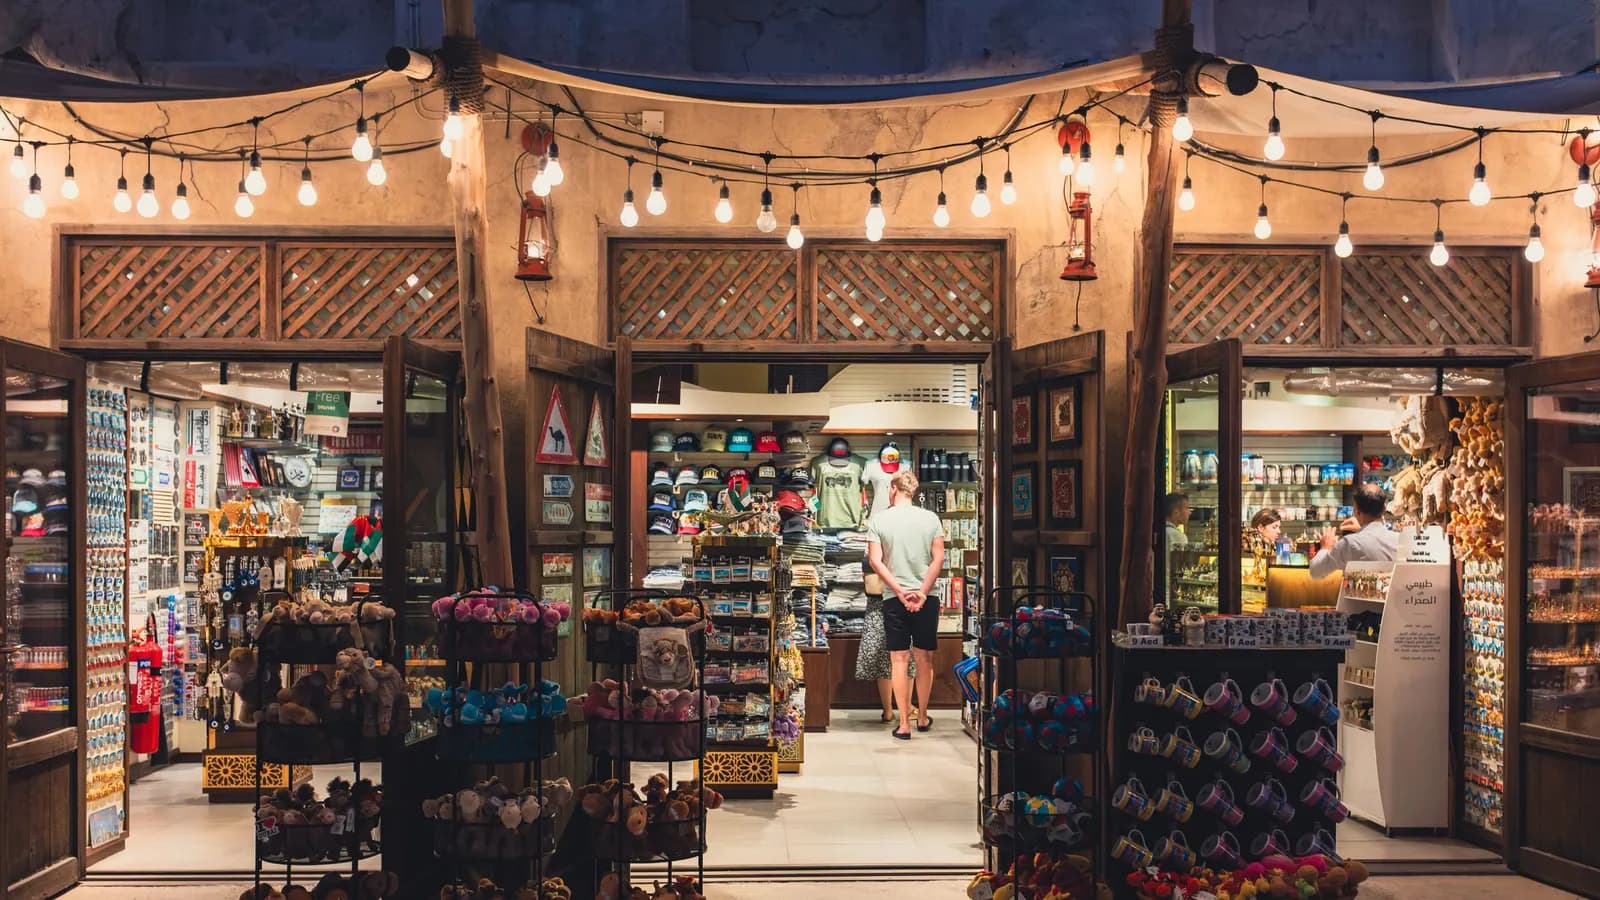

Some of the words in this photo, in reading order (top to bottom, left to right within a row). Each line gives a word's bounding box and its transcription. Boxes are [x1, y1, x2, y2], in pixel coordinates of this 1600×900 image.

[315, 391, 340, 402] Free
[1405, 595, 1437, 606] الصحراء
[1131, 637, 1138, 646] 9
[1140, 637, 1158, 645] Aed
[1230, 638, 1236, 646] 9
[1238, 638, 1256, 646] Aed
